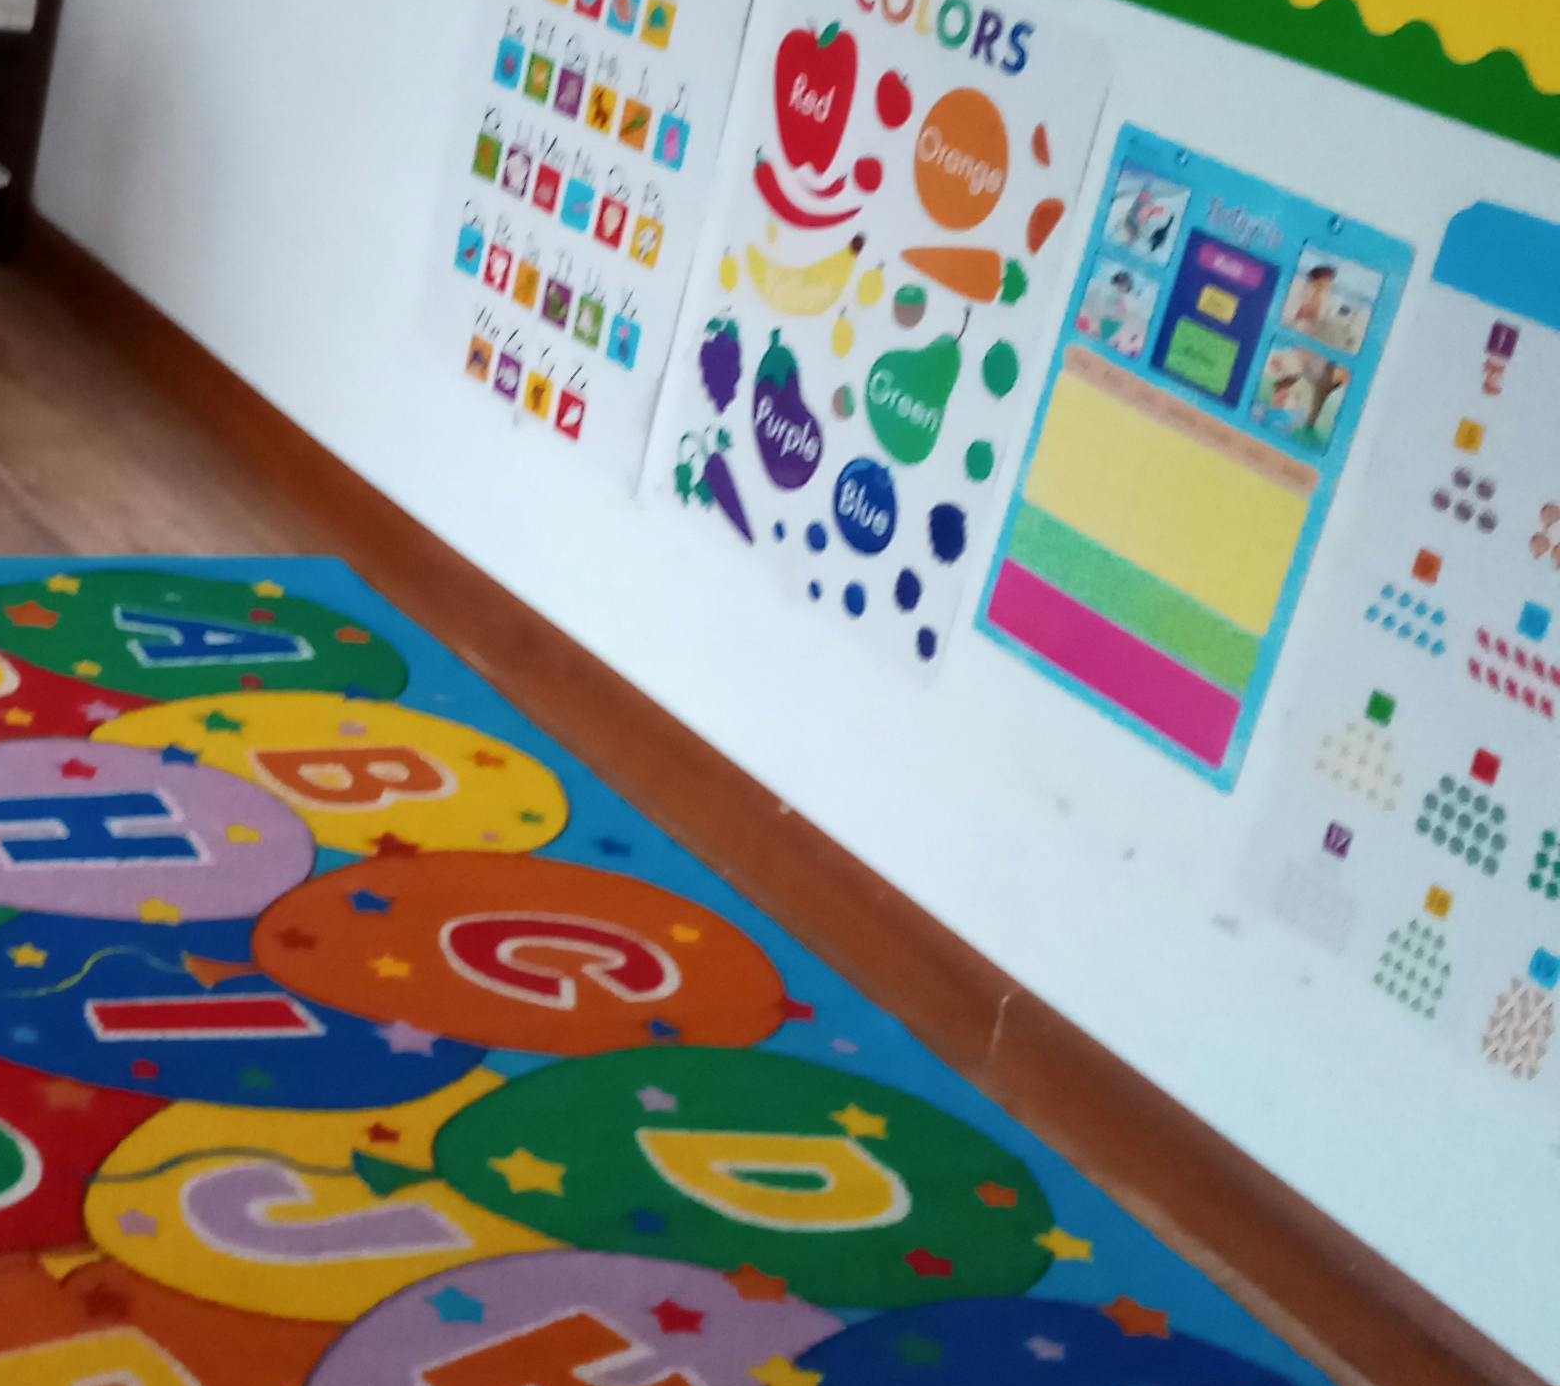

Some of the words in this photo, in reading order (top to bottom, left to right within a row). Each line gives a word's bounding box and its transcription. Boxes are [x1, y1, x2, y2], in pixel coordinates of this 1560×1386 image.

[788, 72, 837, 124] Red
[918, 125, 1004, 197] Orange
[754, 393, 822, 463] Purple
[867, 368, 941, 433] Green
[836, 477, 892, 538] Blue
[114, 605, 314, 668] A
[251, 747, 457, 812] B
[440, 912, 682, 1010] C
[85, 992, 327, 1040] I
[180, 1157, 475, 1265] J
[636, 1128, 910, 1231] D
